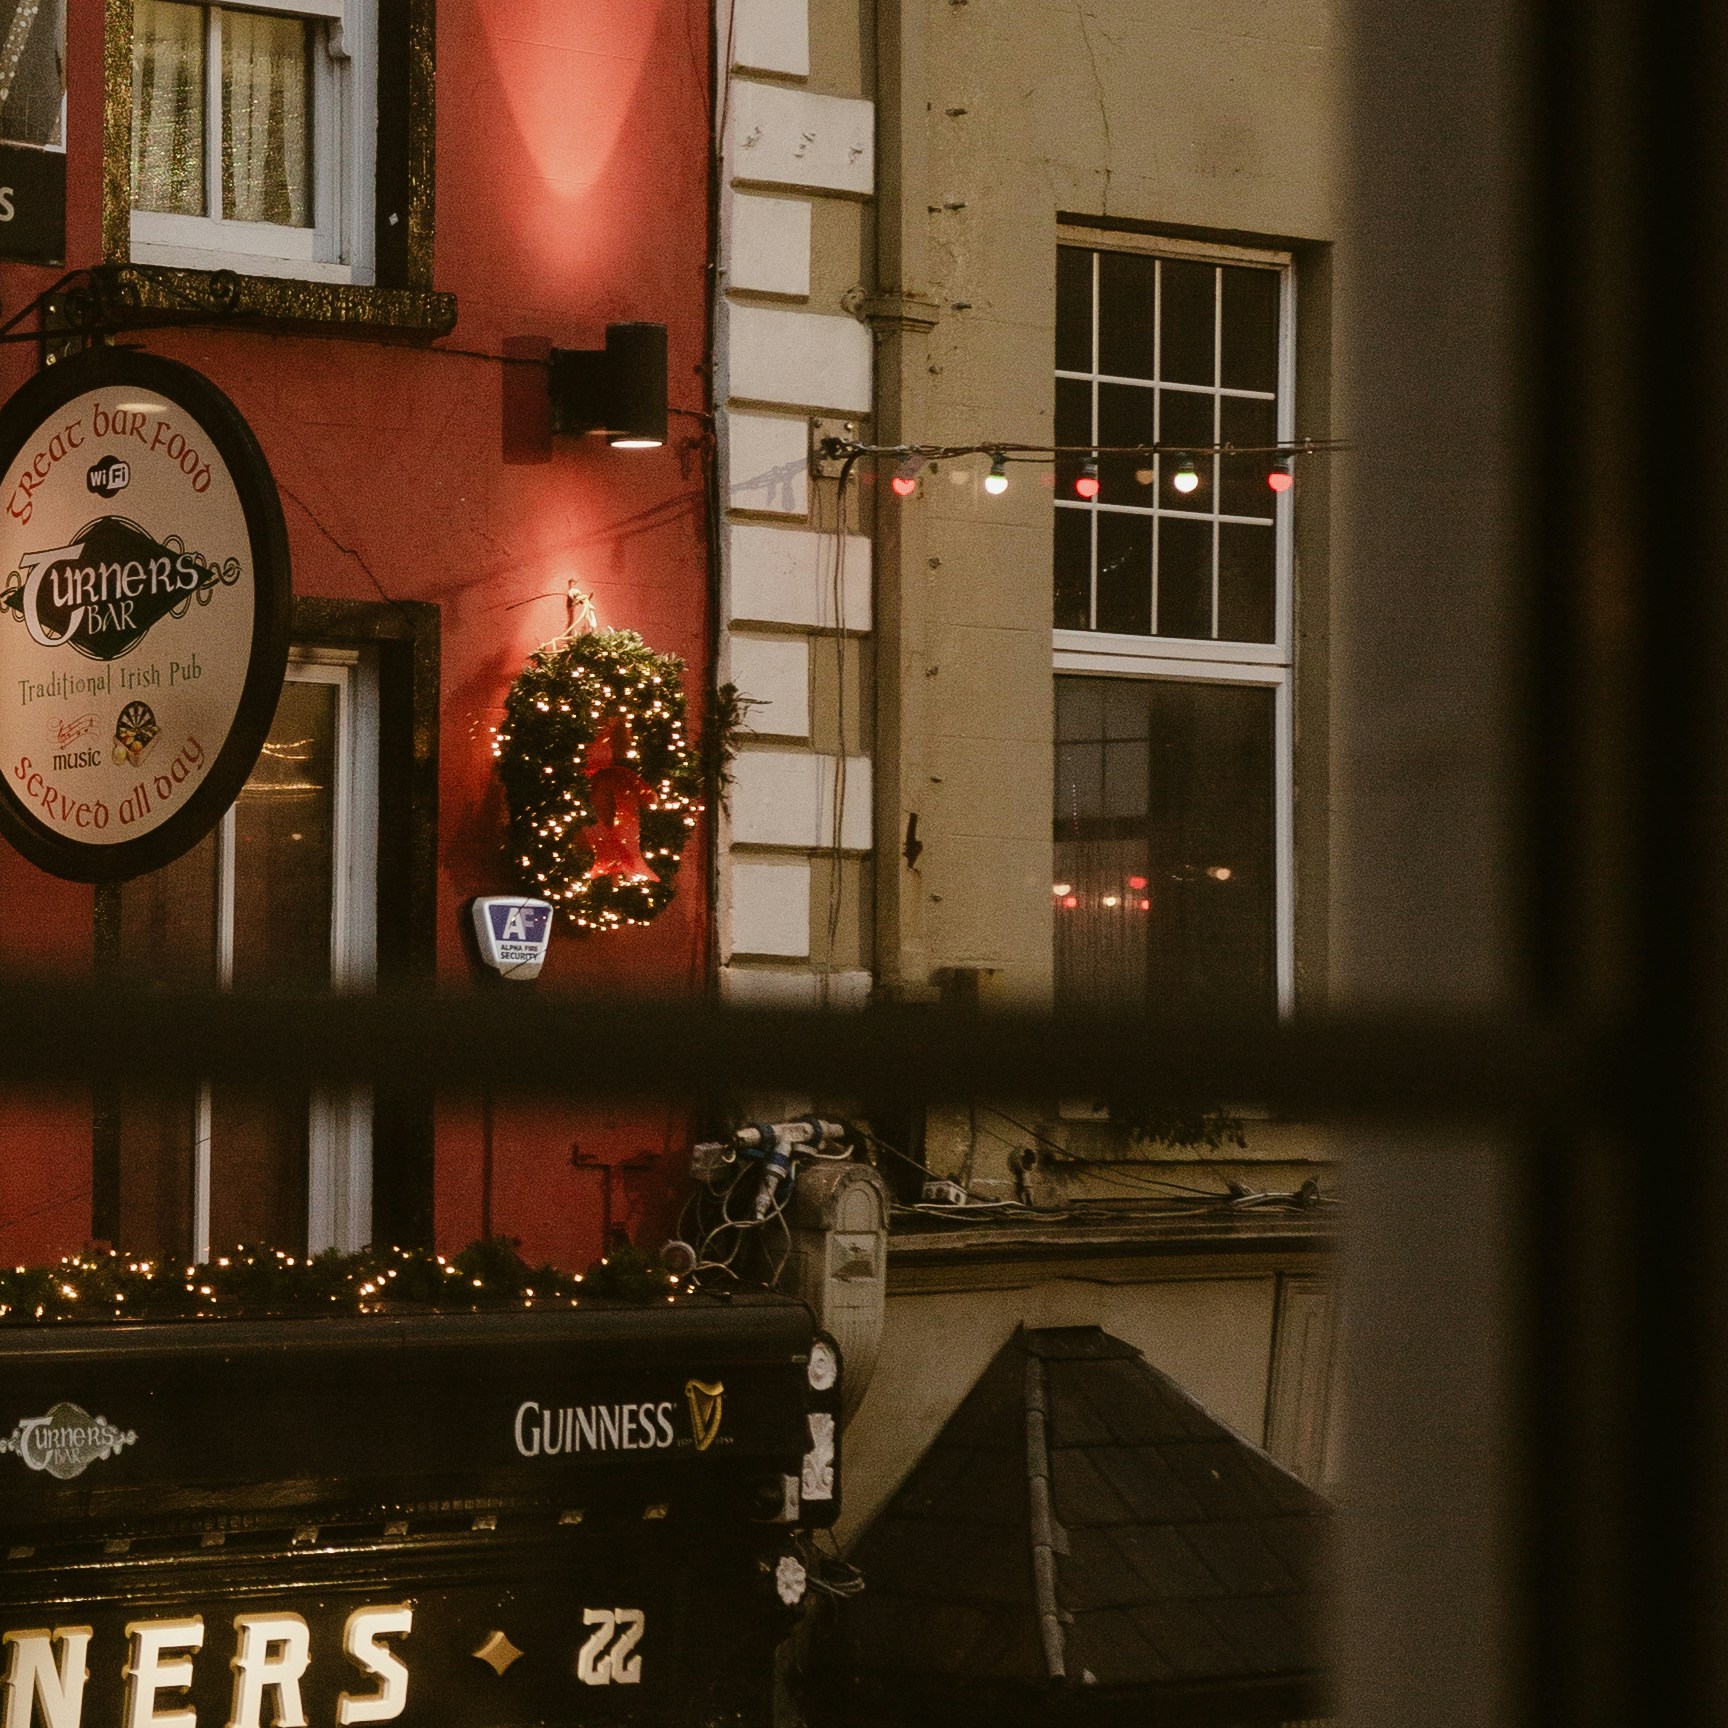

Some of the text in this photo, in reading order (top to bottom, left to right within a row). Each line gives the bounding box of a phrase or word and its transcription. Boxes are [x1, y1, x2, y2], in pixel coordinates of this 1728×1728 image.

[93, 402, 148, 444] bar
[18, 653, 203, 707] Traditional Irish Pub
[52, 747, 102, 771] music
[118, 782, 152, 825] all
[153, 735, 205, 801] day
[500, 944, 523, 952] ALPHA
[500, 951, 539, 960] SECURITY
[514, 1401, 673, 1457] GUINNESS
[576, 1606, 646, 1687] 22
